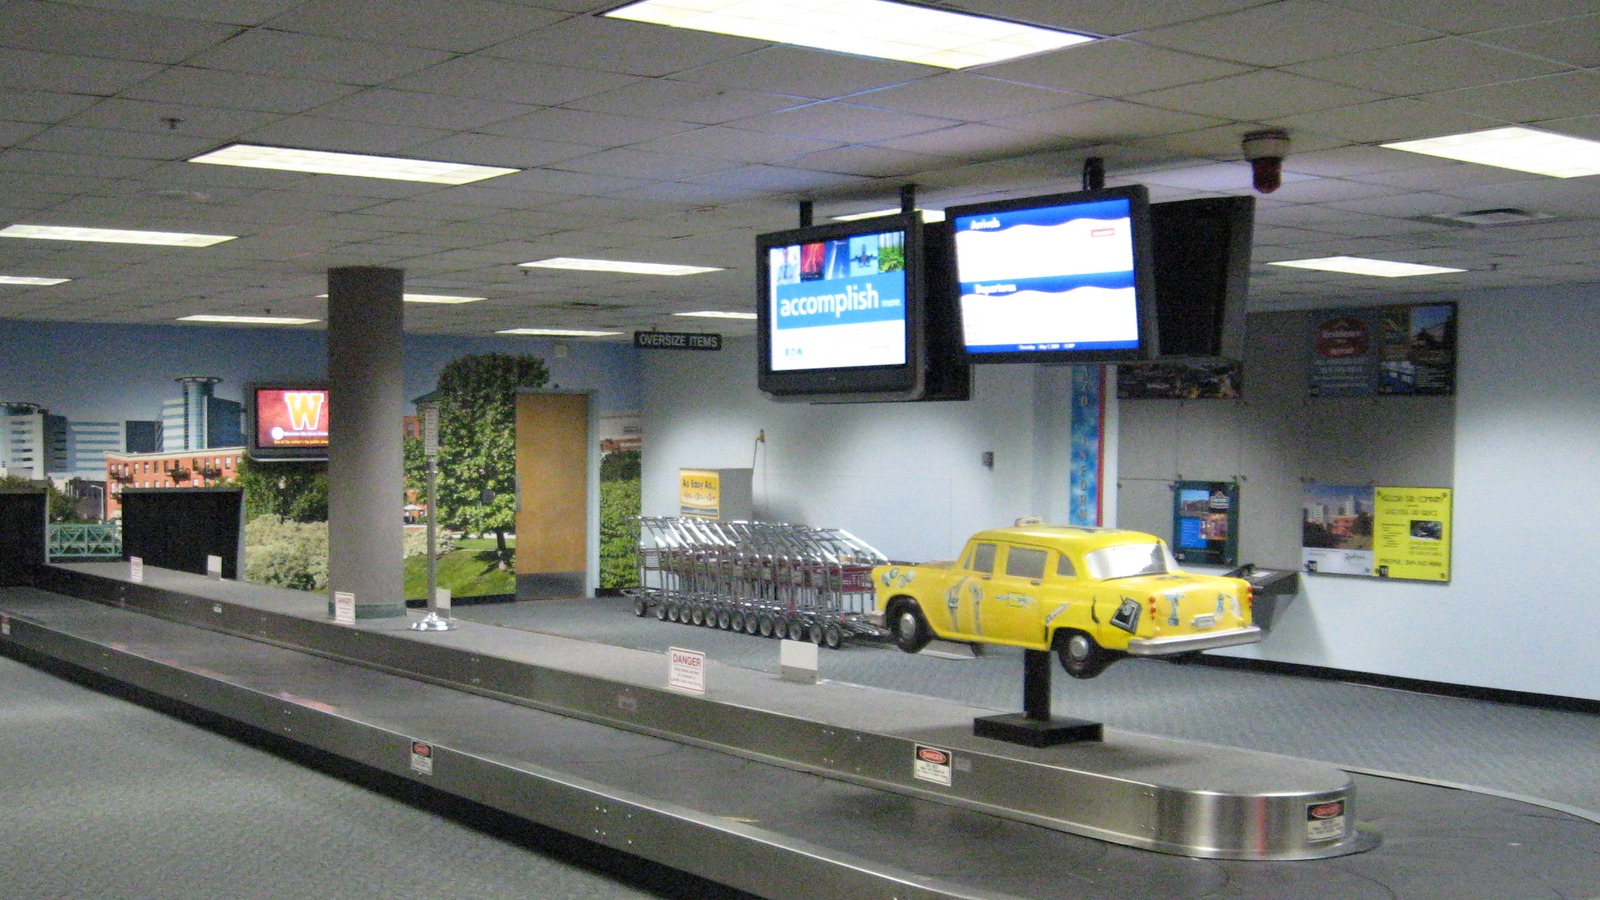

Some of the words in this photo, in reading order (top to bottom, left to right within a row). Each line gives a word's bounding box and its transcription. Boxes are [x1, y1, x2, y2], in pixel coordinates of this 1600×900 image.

[970, 217, 1001, 230] Arrivals
[780, 283, 879, 318] accomplish
[640, 334, 686, 346] OVERSIZE
[690, 336, 718, 348] ITEMS
[284, 392, 325, 430] W
[683, 480, 689, 488] As
[691, 480, 703, 490] Easy
[673, 654, 701, 667] DANGER
[922, 751, 945, 760] DANGER
